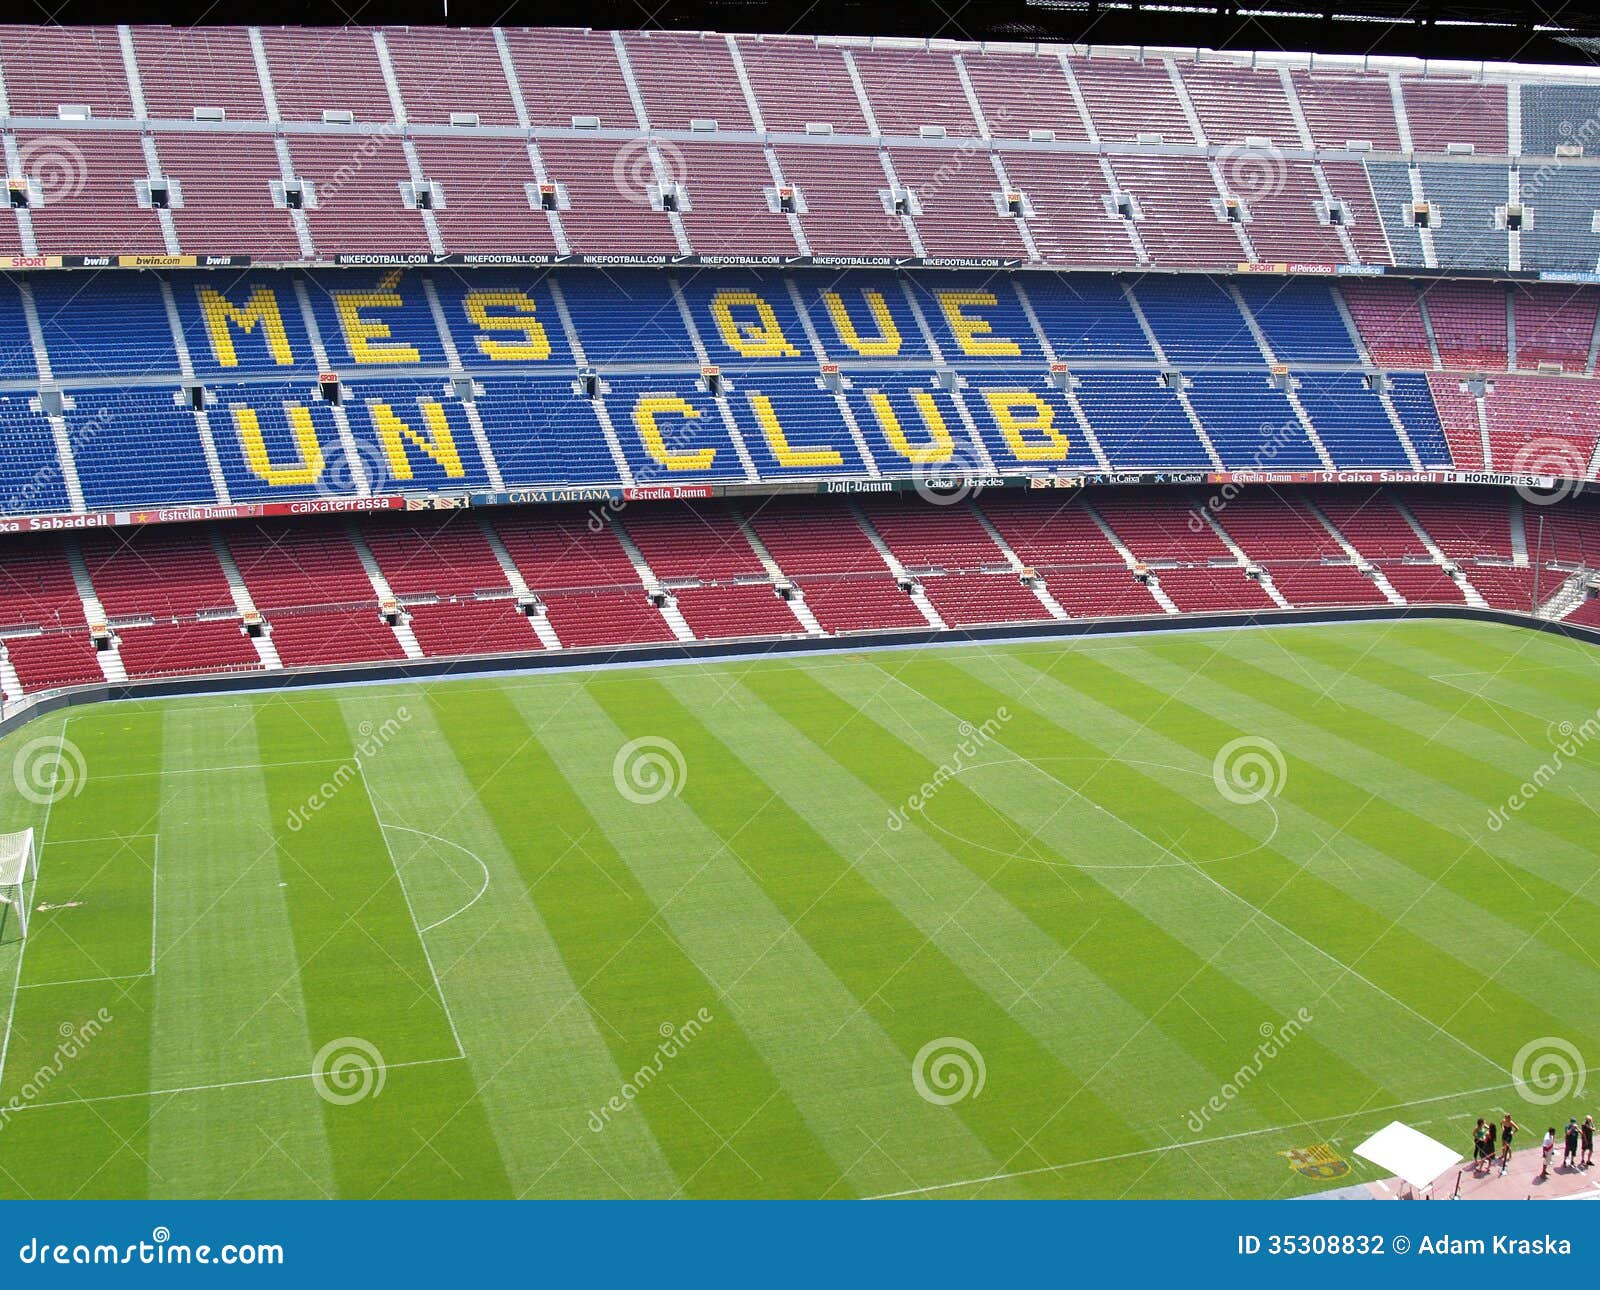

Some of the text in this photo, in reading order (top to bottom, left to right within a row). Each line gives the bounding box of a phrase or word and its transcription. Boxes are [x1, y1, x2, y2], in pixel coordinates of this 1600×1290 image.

[12, 257, 48, 267] SPORT
[83, 256, 110, 266] bwin
[136, 257, 181, 265] bwin.com
[206, 256, 231, 266] bwin
[339, 254, 428, 264] NIKEFOOTBALL.COM
[463, 254, 549, 264] NIKEFOOTBALL.COM
[582, 255, 666, 264] NIKEFOOTBALL.COM
[699, 256, 780, 265] NIKEFOOTBALL.COM
[812, 256, 890, 266] NIKEFOOTBALL.COM
[922, 258, 999, 267] NIKEFOOTBALL.COM
[1249, 264, 1275, 272] SPORT
[708, 288, 1022, 357] QUE
[822, 365, 838, 373] SPORT
[1051, 364, 1067, 372] SPORT
[319, 374, 337, 382] SPORT
[231, 390, 1071, 487] UN CLUB
[1231, 472, 1293, 483] Estrella Damm
[1338, 472, 1437, 482] Caixa Sabadell
[1464, 474, 1541, 487] HORMIPRESA
[827, 480, 893, 493] Voll-Damm
[924, 479, 953, 488] Caixa
[509, 489, 611, 503] CAIXA LAIETANA
[629, 486, 707, 500] Estrella Damm
[290, 498, 389, 513] caixaterrassa
[158, 507, 238, 521] Estrella Damm
[29, 515, 108, 530] Sabadell
